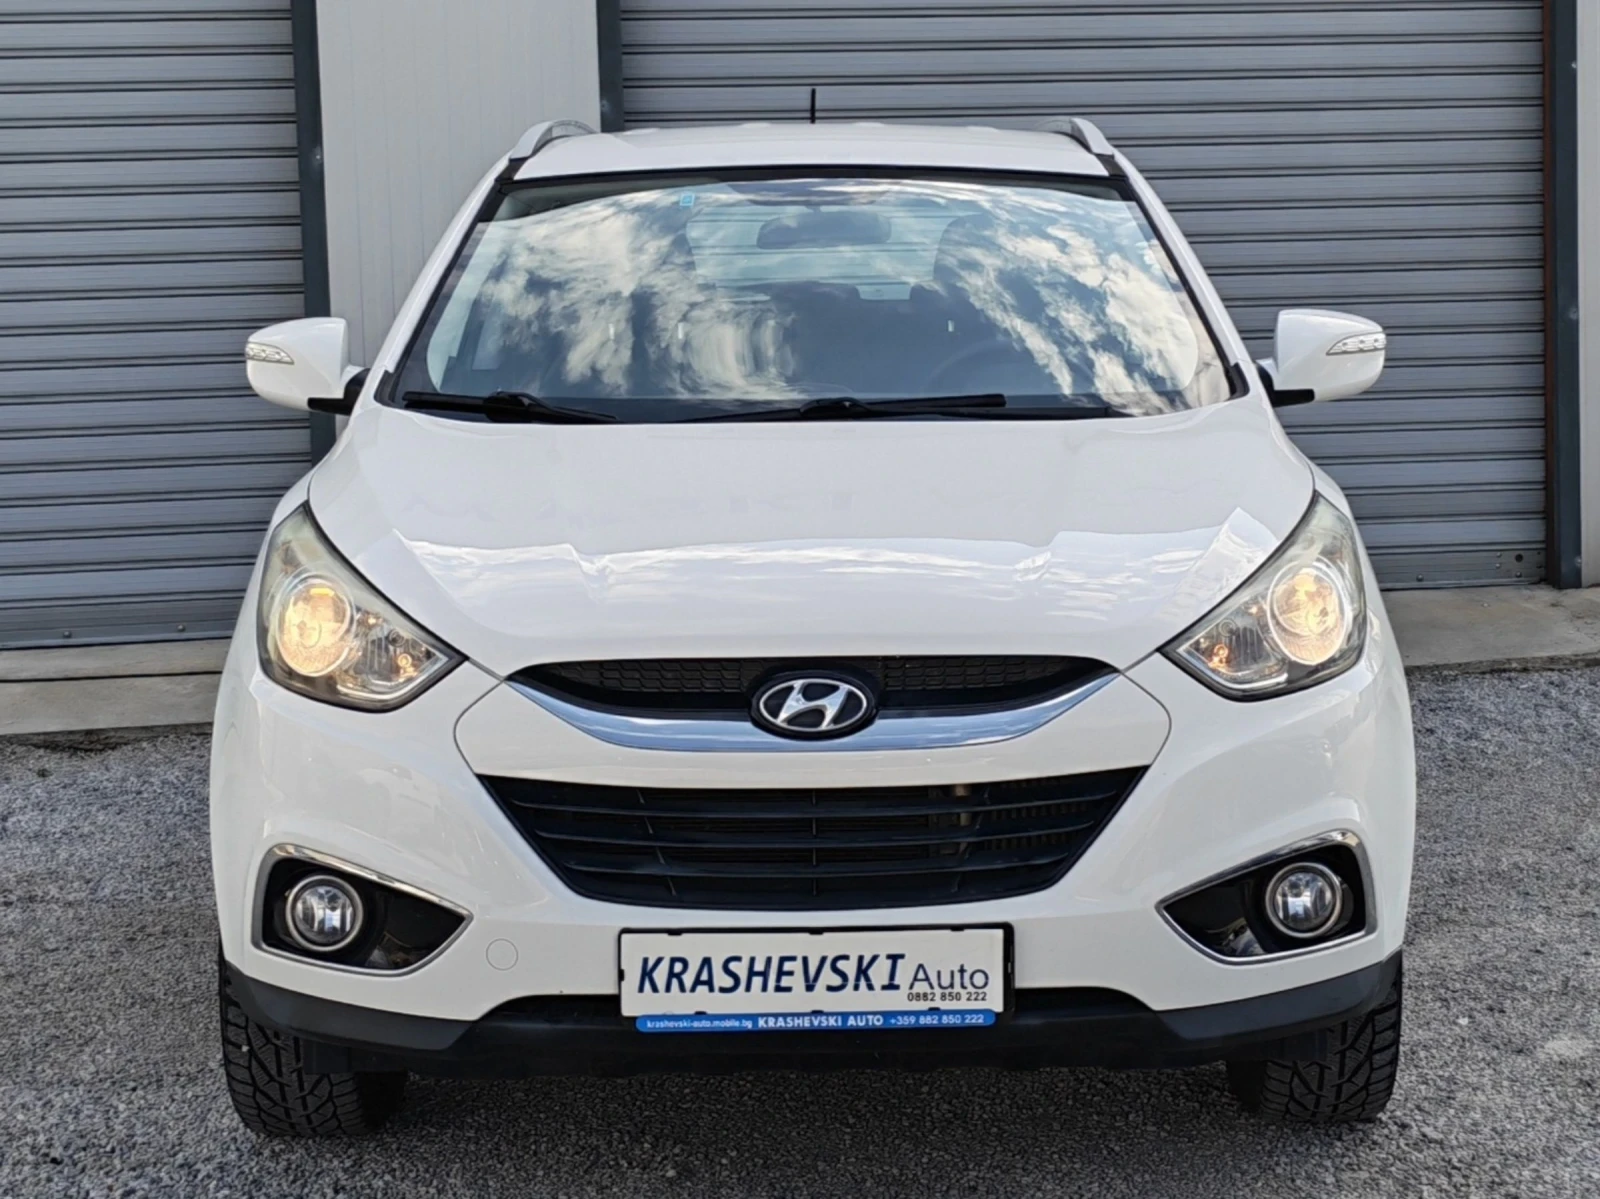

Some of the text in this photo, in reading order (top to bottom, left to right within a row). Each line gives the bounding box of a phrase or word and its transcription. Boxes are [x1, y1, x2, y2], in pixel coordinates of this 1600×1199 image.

[637, 953, 990, 994] KRASHEVSKI Auto
[907, 990, 988, 1002] 0882 850 222
[757, 1014, 842, 1028] KRASHEVSKI
[847, 1014, 884, 1027] AUTO
[889, 1015, 916, 1026] +359
[919, 1015, 939, 1025] 882
[941, 1014, 962, 1025] 850
[964, 1013, 985, 1024] 222
